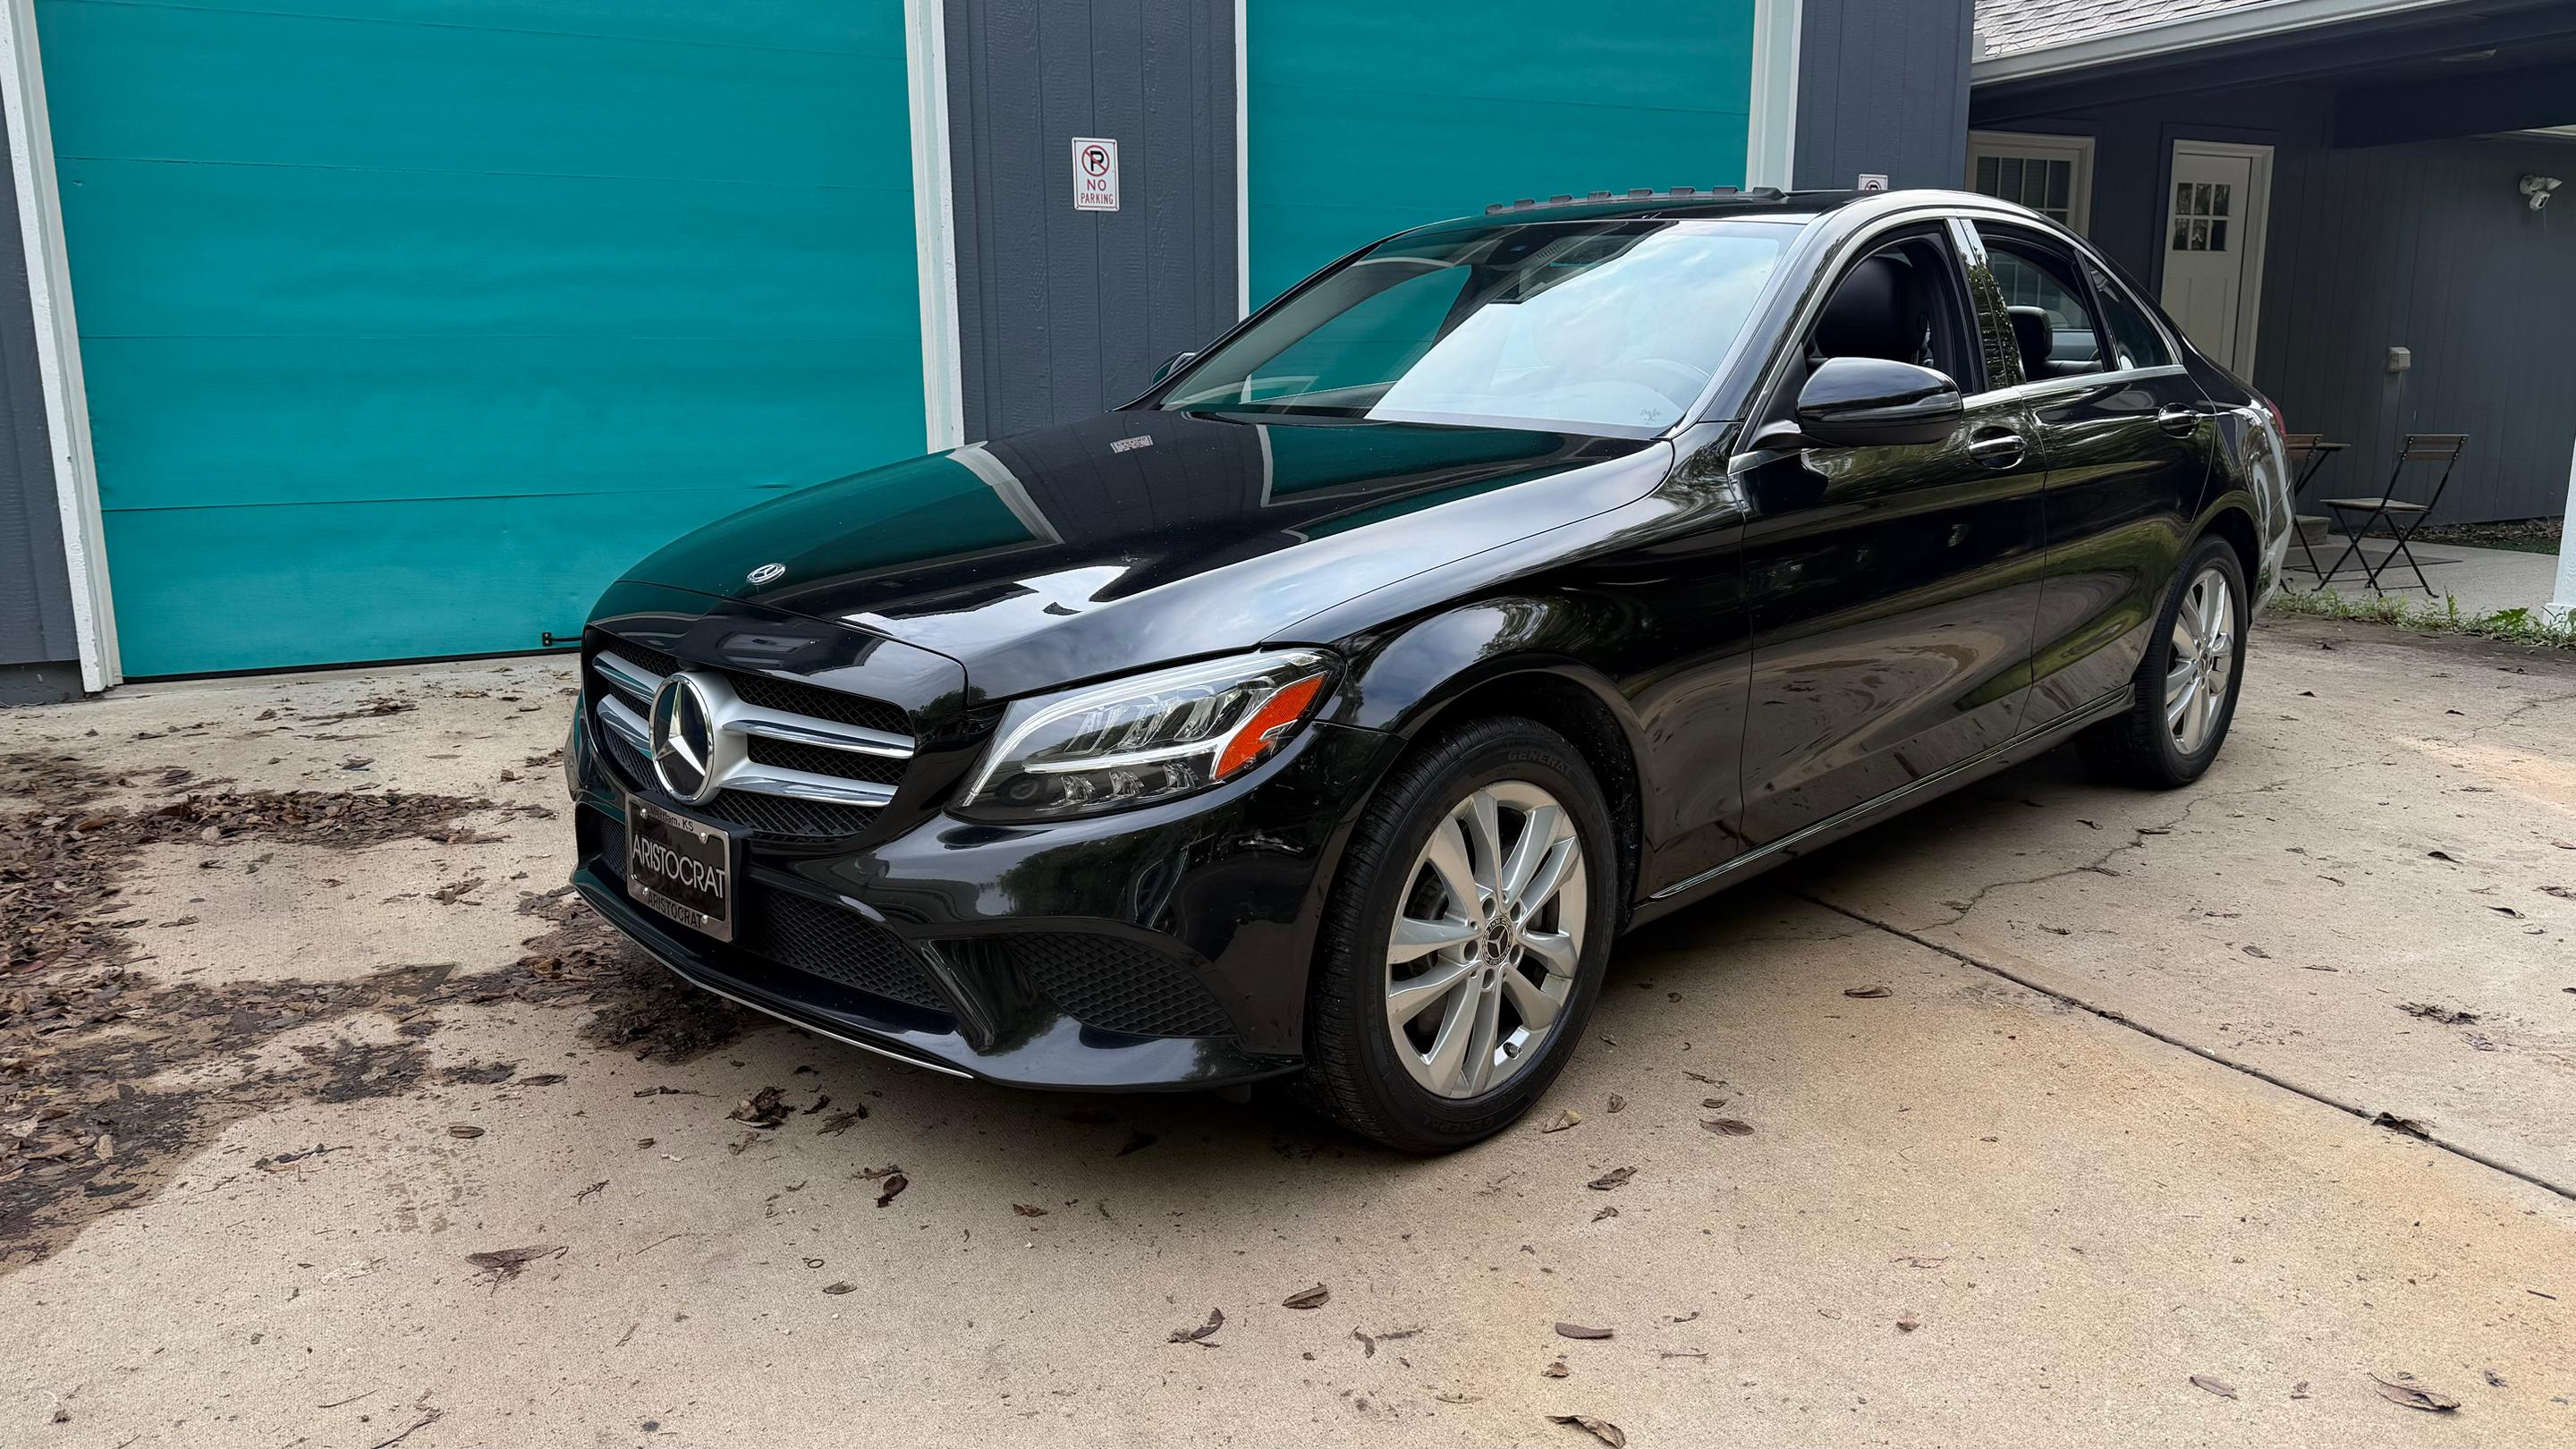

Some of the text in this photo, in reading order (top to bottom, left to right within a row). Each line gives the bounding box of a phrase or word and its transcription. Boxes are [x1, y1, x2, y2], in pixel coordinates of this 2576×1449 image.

[1087, 179, 1106, 191] NO
[1080, 192, 1114, 205] PARKING
[1508, 750, 1573, 778] GENERAL
[682, 818, 694, 832] KS
[632, 834, 725, 899] ARISTOCRAT
[648, 891, 702, 929] ARISTOCRAT
